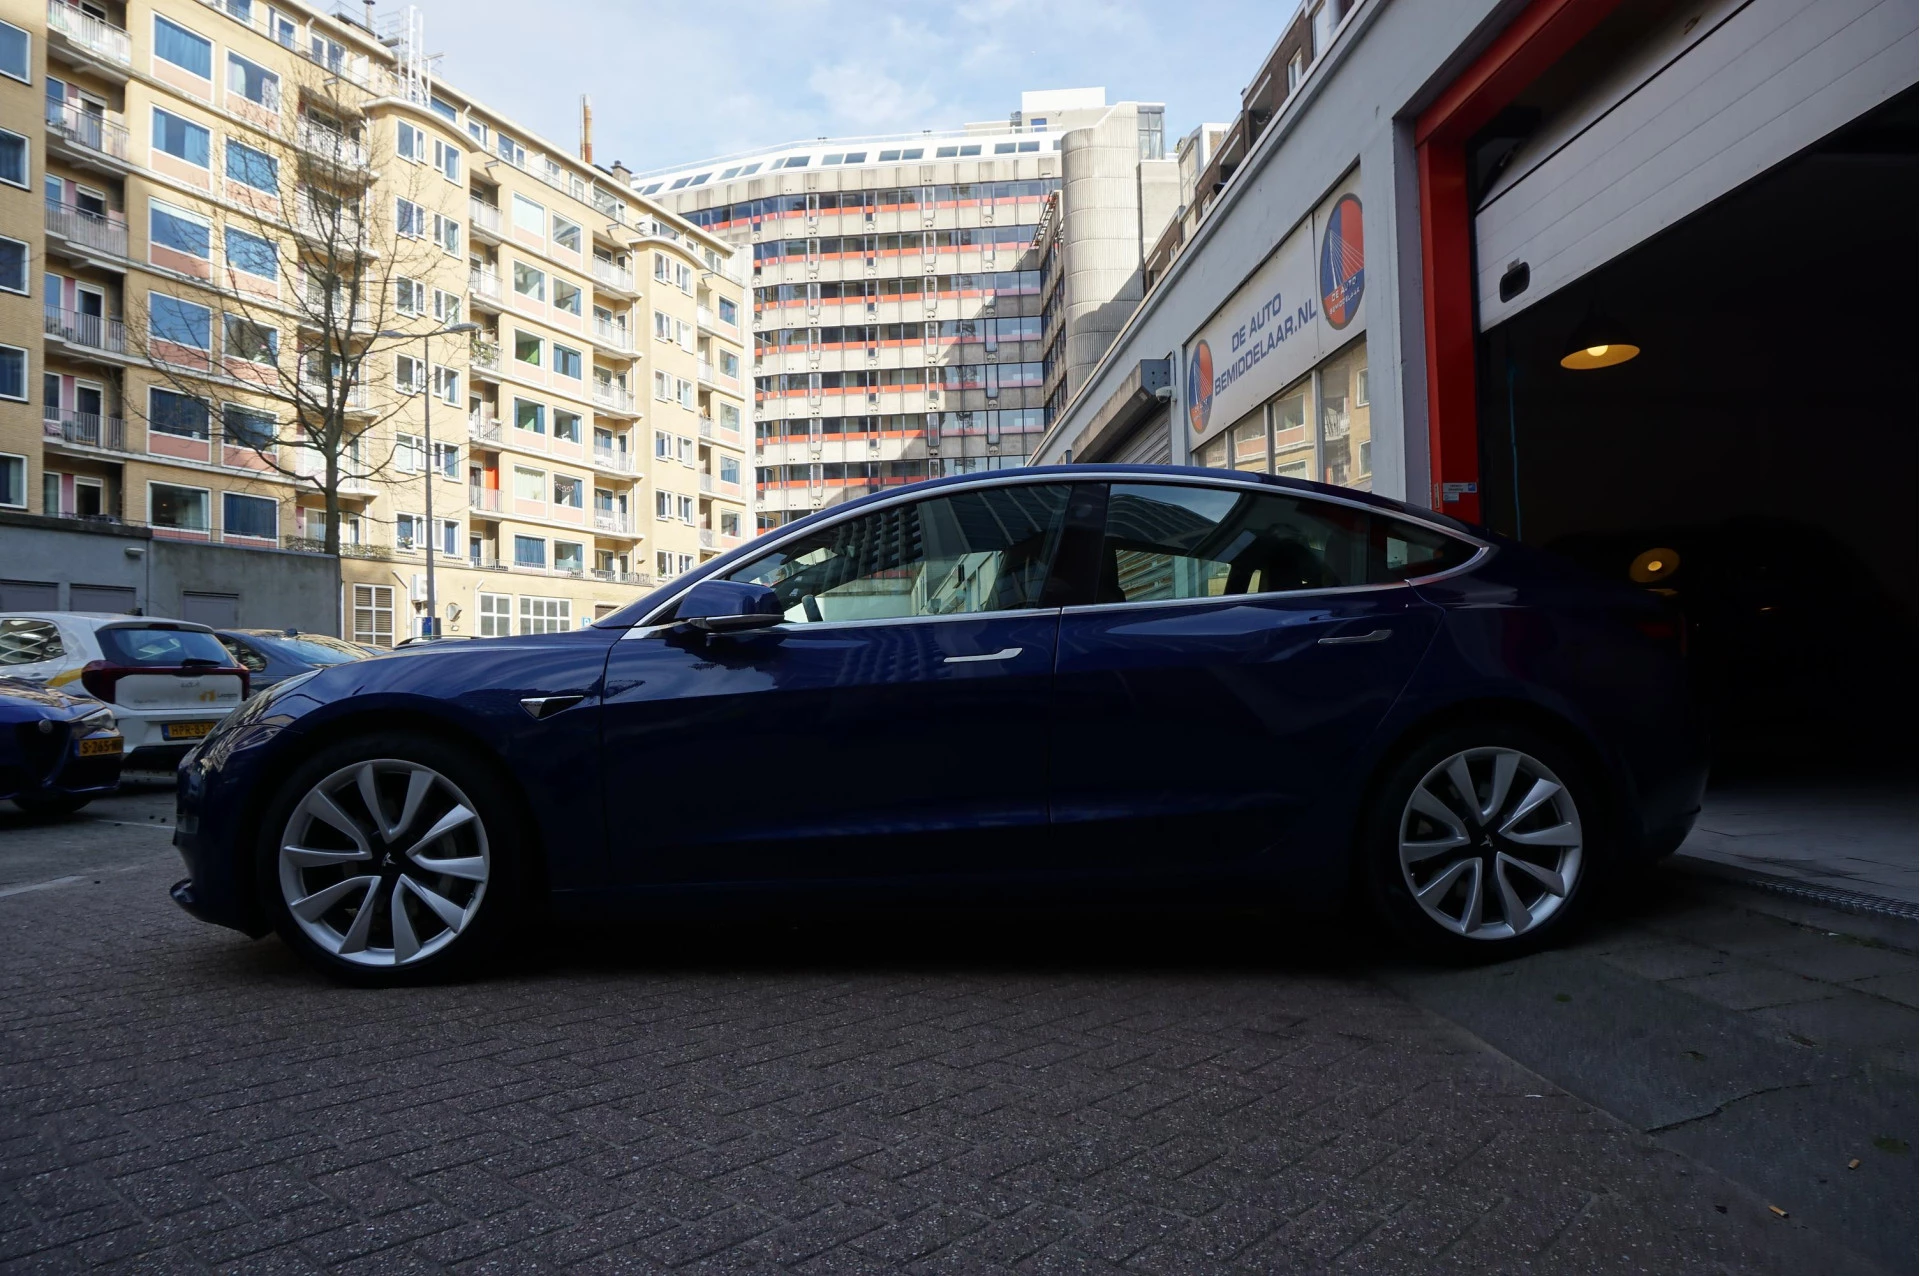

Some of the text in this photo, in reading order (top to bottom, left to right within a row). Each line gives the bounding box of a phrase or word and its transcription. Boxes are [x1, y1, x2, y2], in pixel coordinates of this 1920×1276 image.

[1214, 298, 1316, 396] BEMIDDELAAR.NL
[1232, 293, 1282, 353] DE AUTO
